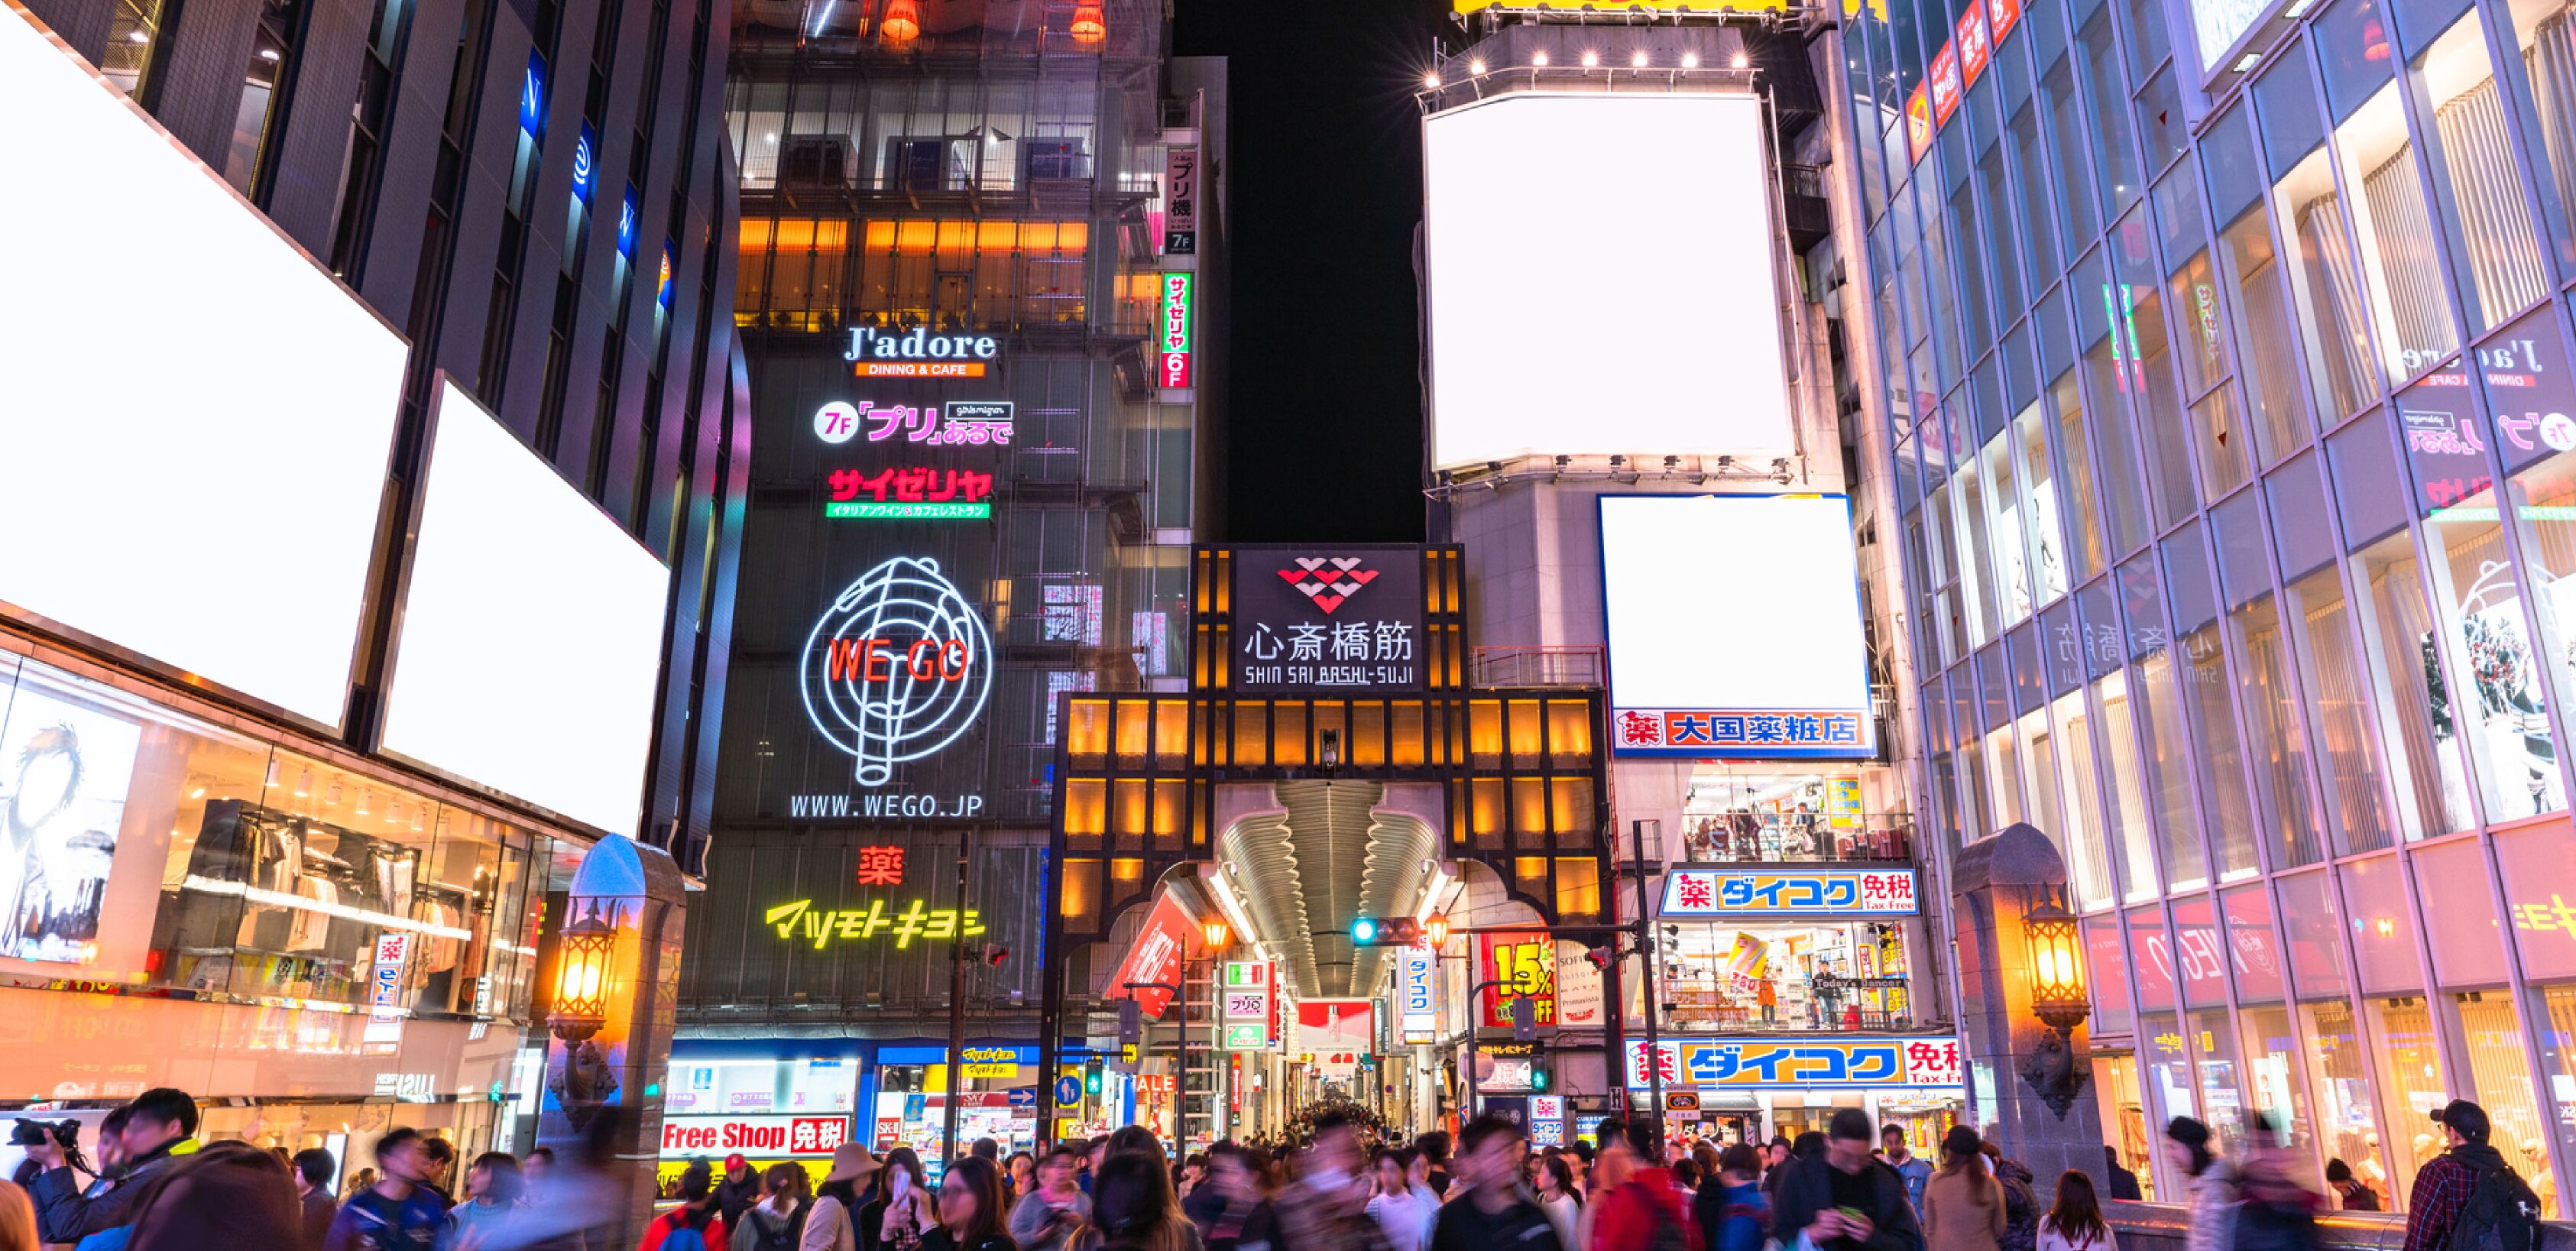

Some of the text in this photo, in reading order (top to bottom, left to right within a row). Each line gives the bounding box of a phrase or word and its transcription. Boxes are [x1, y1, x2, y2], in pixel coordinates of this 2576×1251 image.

[1171, 163, 1193, 216] プリ機
[1172, 234, 1190, 248] 7F
[1168, 277, 1185, 349] サイゼリヤ
[844, 327, 996, 360] J'adore
[869, 365, 967, 375] DINING & CAFE
[1167, 354, 1183, 387] 6F
[825, 413, 851, 434] 7F
[829, 467, 992, 502] サイゼリヤ
[1244, 621, 1413, 662] 心斎橋筋
[830, 638, 968, 682] WE GO
[1246, 666, 1282, 684] SHIN
[1288, 666, 1314, 684] SAI
[1625, 711, 1857, 744] 薬 大国薬粧店
[791, 795, 983, 817] WWW.WEGO.JP
[857, 845, 905, 886] 薬
[1679, 874, 1913, 909] 薬 ダイコク 免税
[1867, 901, 1913, 910] Tax-Free
[766, 899, 986, 949] マツモトキヨシ
[1409, 961, 1427, 1009] ダイコク
[1495, 941, 1554, 996] 15%
[1534, 999, 1554, 1023] FF
[1689, 1047, 1896, 1081] ダイコク
[663, 1120, 844, 1150] Free Shop 免税
